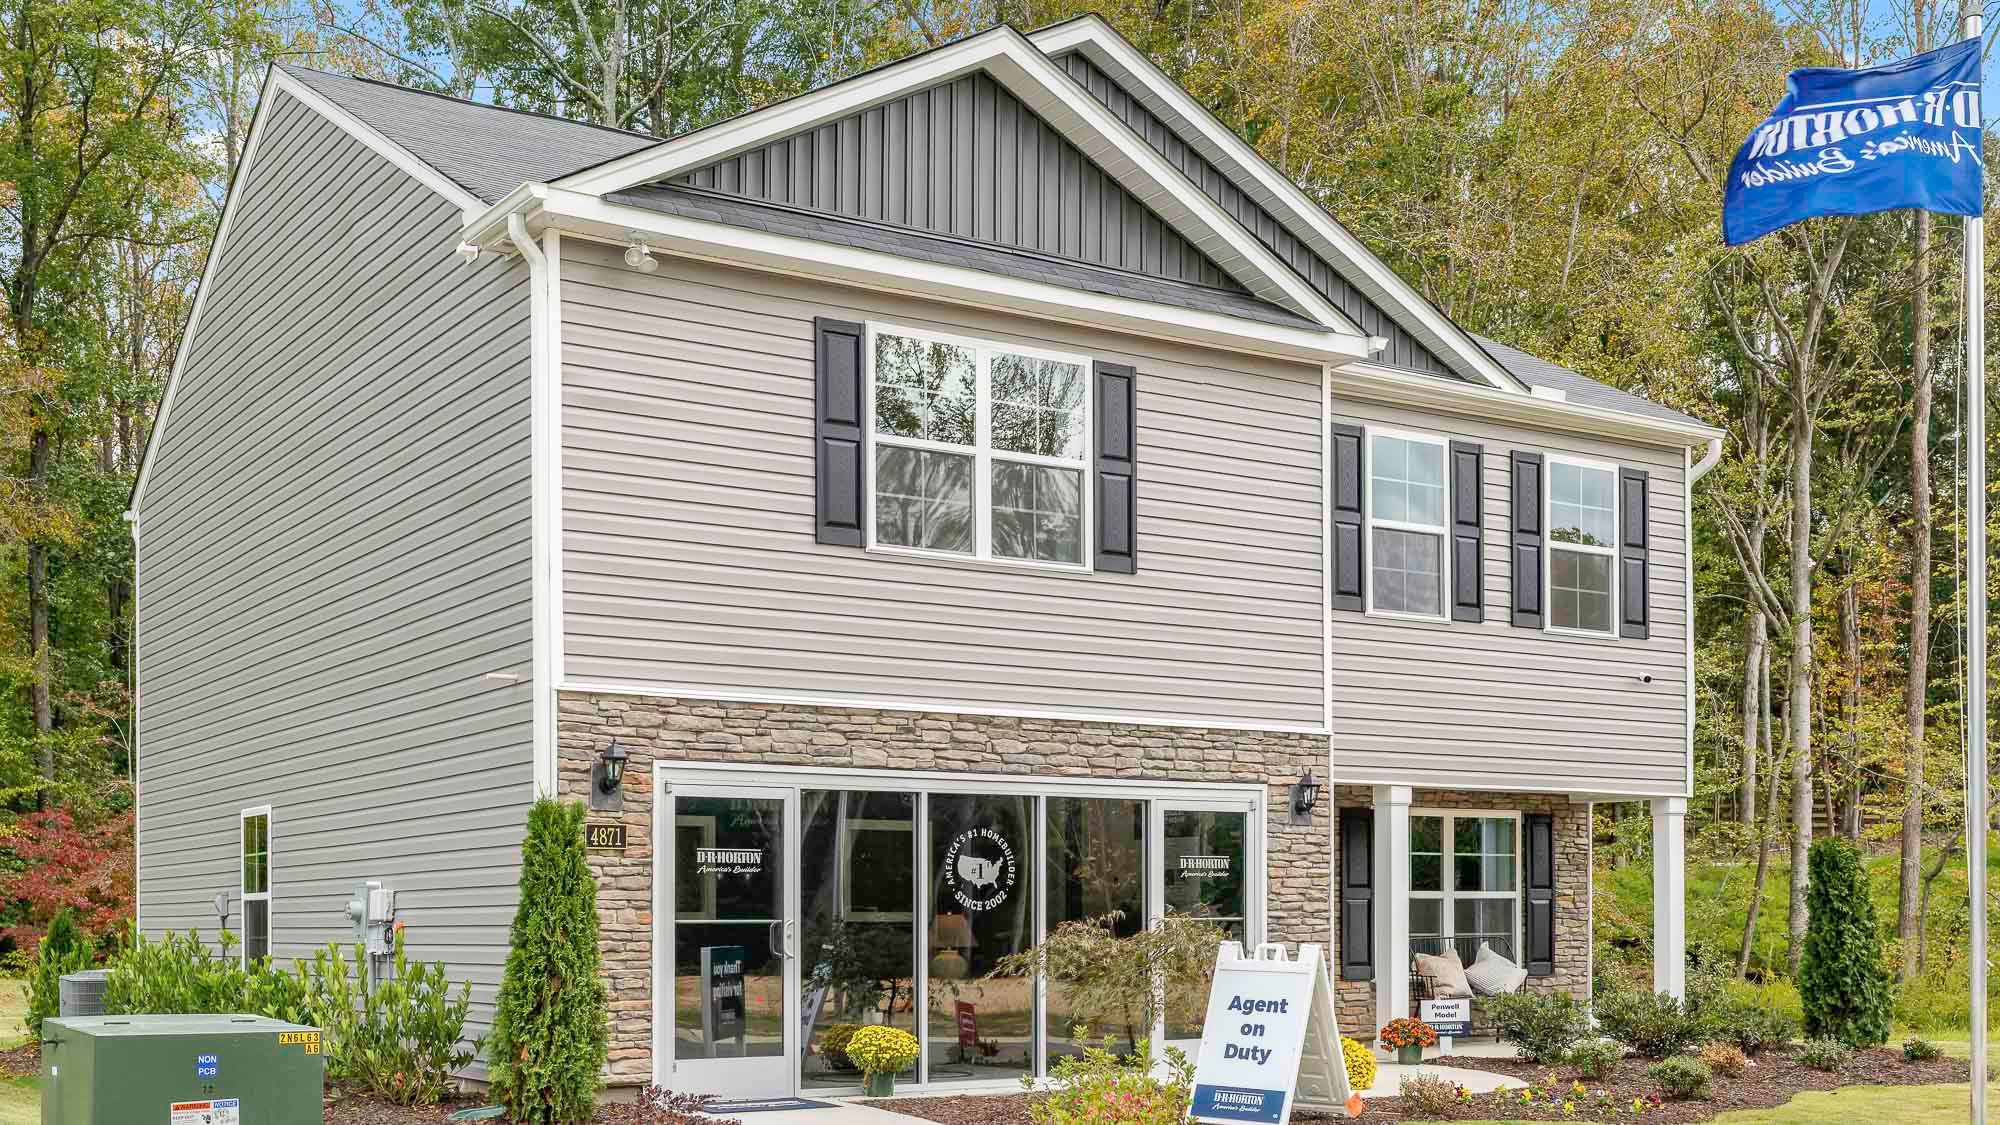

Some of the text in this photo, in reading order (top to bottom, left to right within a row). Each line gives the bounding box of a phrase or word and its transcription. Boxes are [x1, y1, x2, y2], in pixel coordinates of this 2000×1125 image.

[590, 827, 622, 846] 4871
[945, 827, 1016, 886] AMERICA'S #1 HOMEBUILDER
[696, 864, 762, 875] America's Builder
[954, 890, 1008, 911] SINCE 2002
[1227, 995, 1289, 1015] Agent
[1240, 1023, 1265, 1037] on
[307, 1044, 319, 1054] A6
[1223, 1043, 1272, 1066] Duty
[198, 1055, 217, 1064] NON
[198, 1067, 217, 1076] PCB
